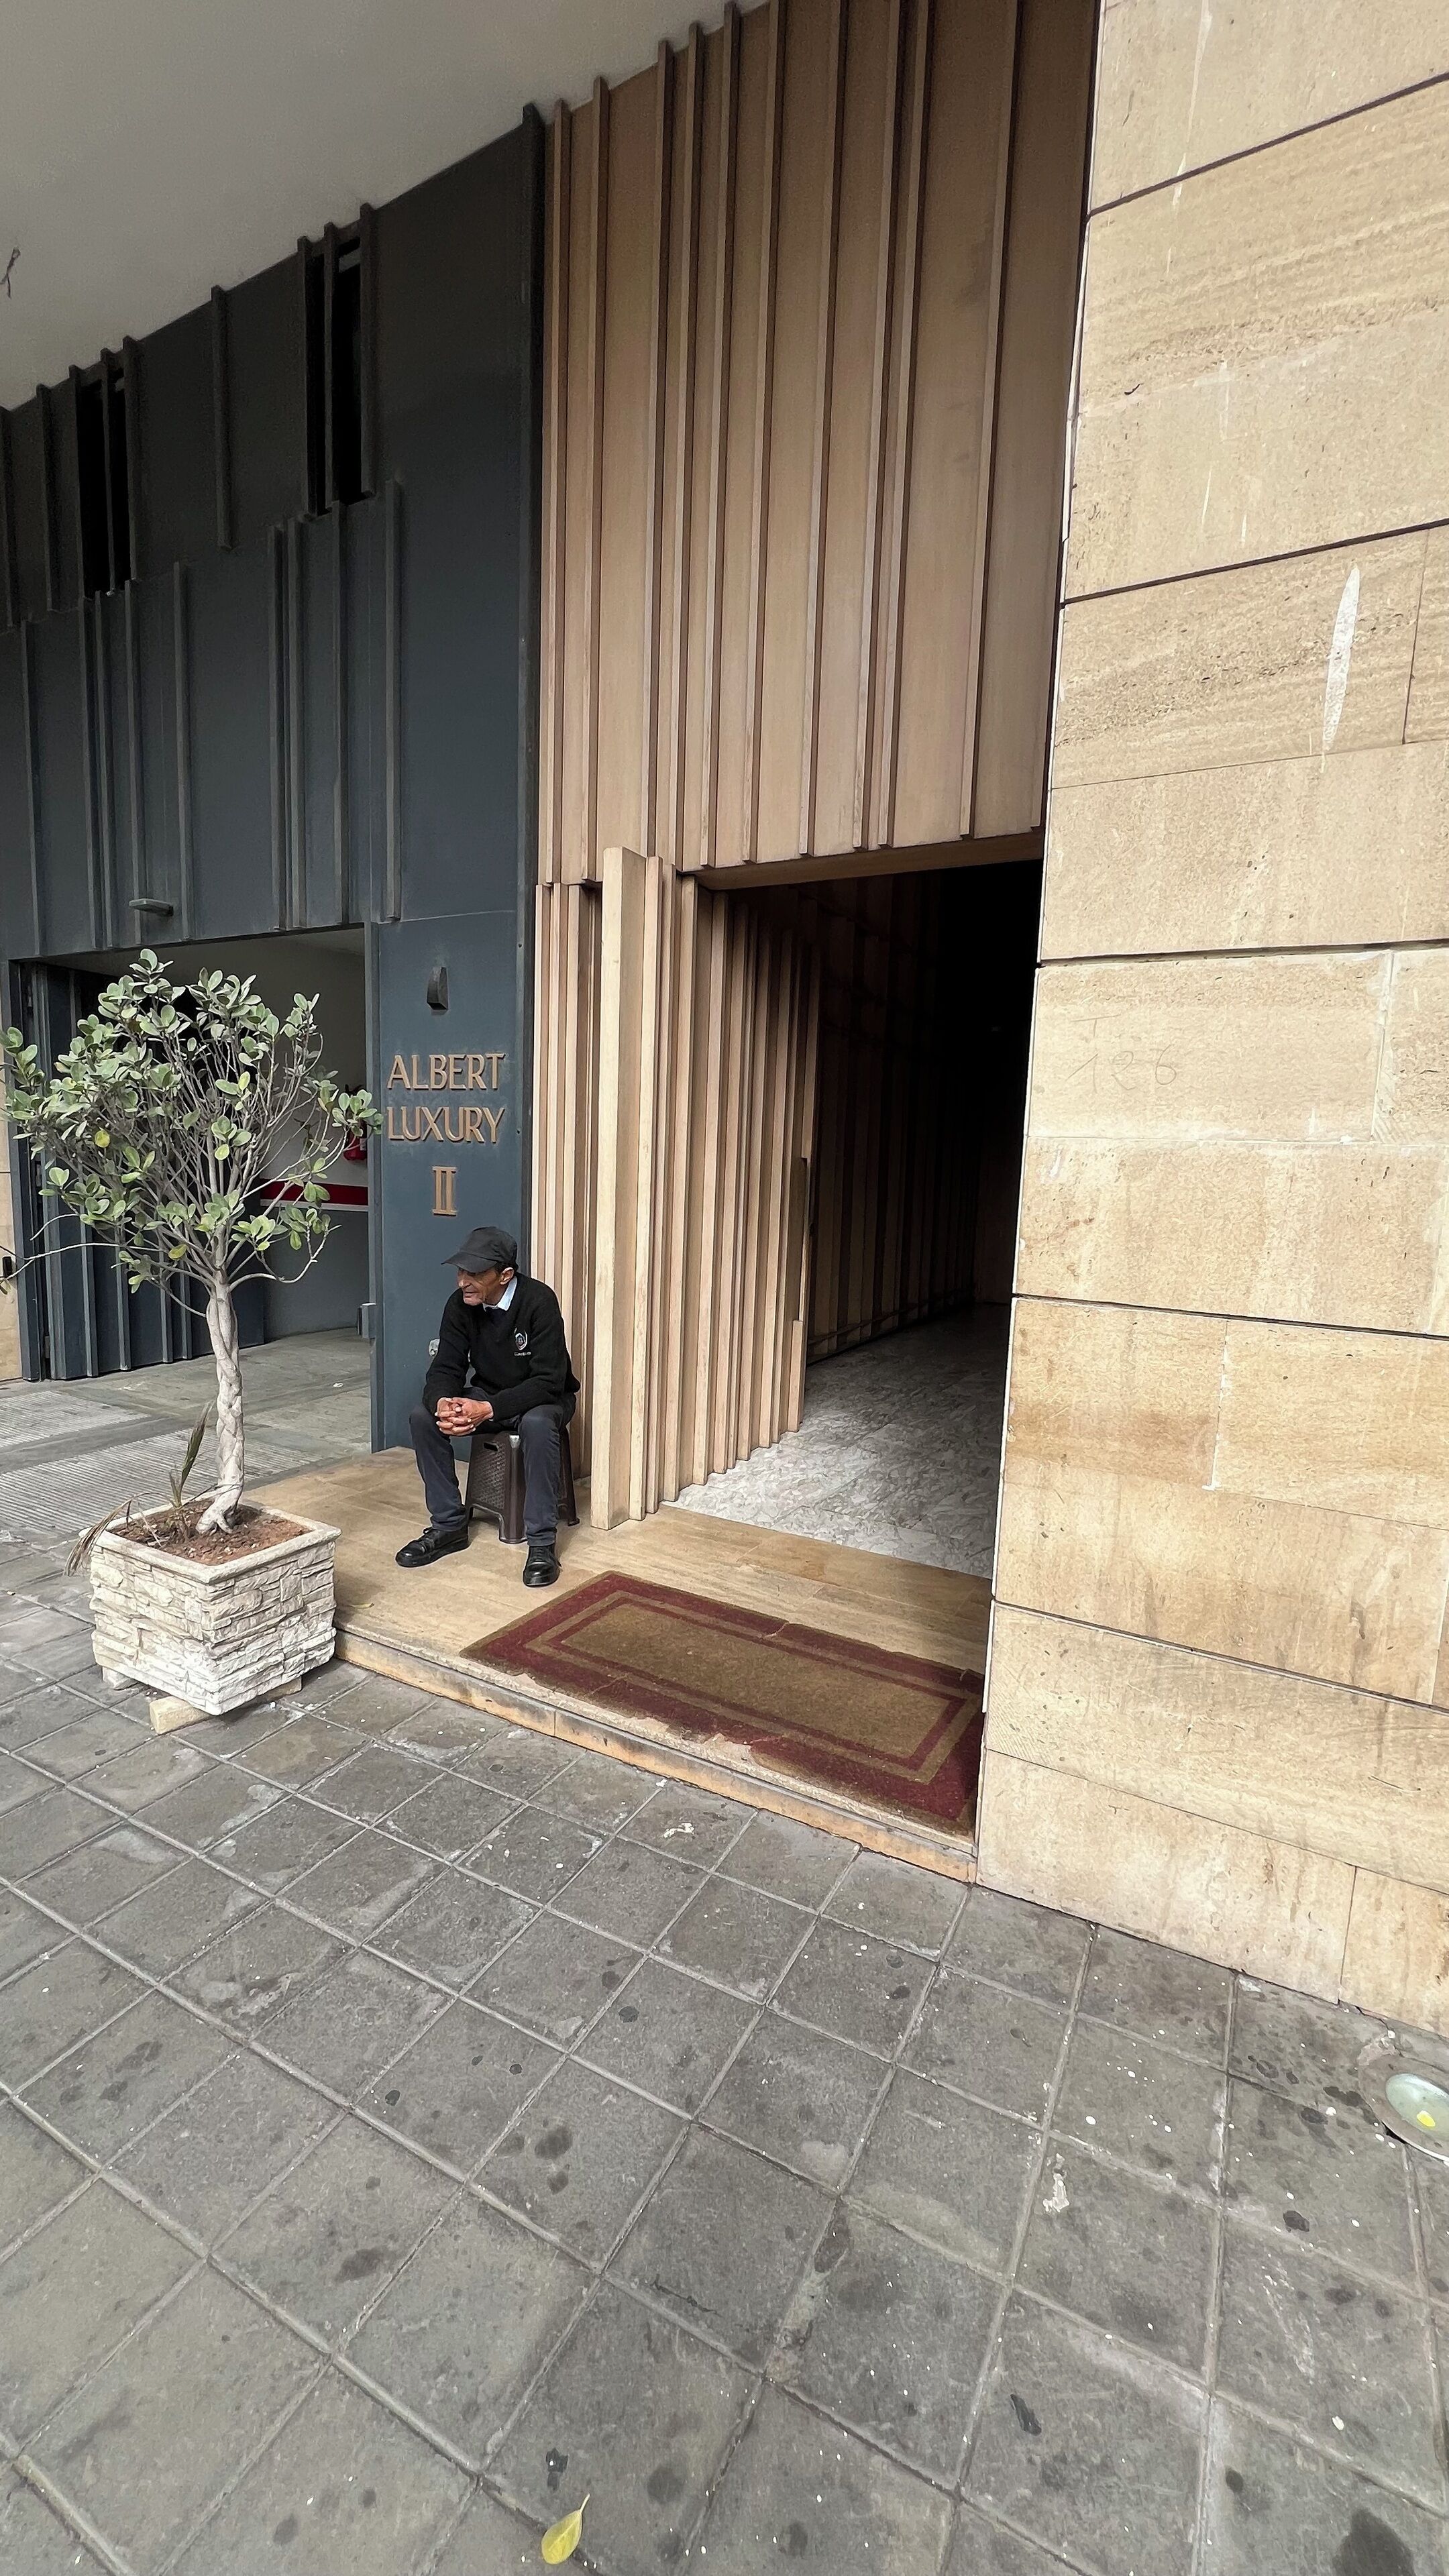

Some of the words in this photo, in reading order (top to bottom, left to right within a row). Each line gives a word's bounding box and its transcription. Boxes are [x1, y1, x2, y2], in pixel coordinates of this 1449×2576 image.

[386, 1053, 505, 1089] ALBERT
[386, 1106, 504, 1142] LUXURY
[432, 1166, 458, 1216] II
